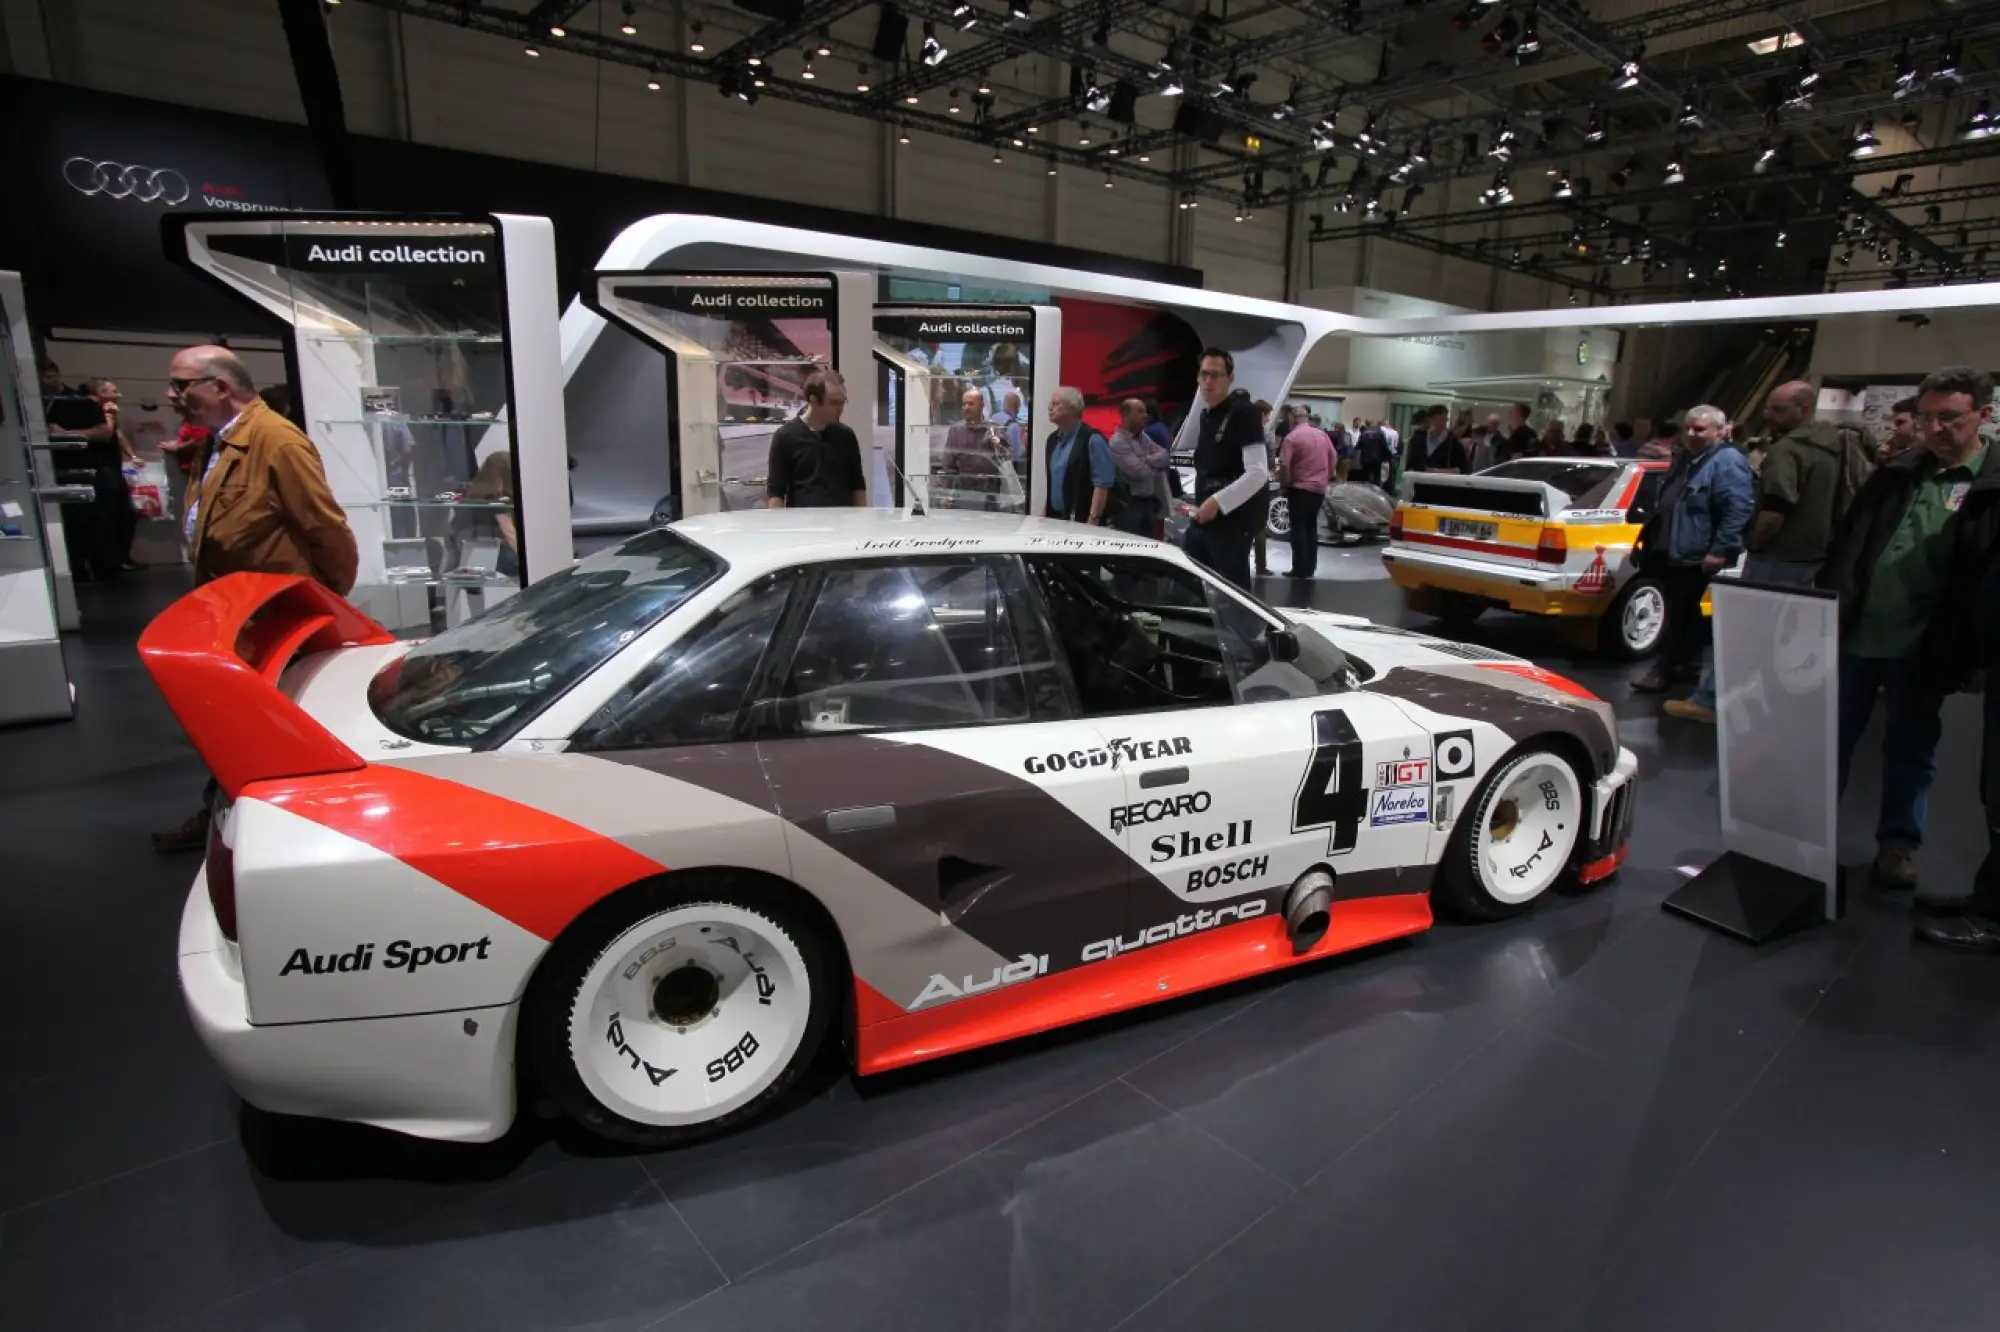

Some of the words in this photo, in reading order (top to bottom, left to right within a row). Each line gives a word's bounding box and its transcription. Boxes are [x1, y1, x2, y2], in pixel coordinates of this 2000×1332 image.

[308, 244, 362, 262] Audi
[369, 245, 485, 263] collection
[691, 293, 732, 307] Audi
[737, 294, 823, 307] collection
[919, 322, 952, 334] Audi
[955, 323, 1024, 335] collection
[1291, 709, 1369, 857] 4
[1374, 791, 1425, 815] Norelco
[1538, 780, 1560, 811] BBS
[1110, 791, 1211, 829] RECARO
[1150, 819, 1253, 864] Shell
[1509, 829, 1553, 878] Audi
[1186, 855, 1269, 893] BOSCH
[279, 943, 375, 977] Audi
[383, 934, 492, 973] Sport
[623, 937, 677, 979] BBS
[707, 936, 775, 1005] Audi
[907, 952, 1049, 1013] Audi
[1081, 899, 1267, 963] quattro
[606, 1012, 678, 1087] Audi
[706, 1031, 759, 1082] BBS
